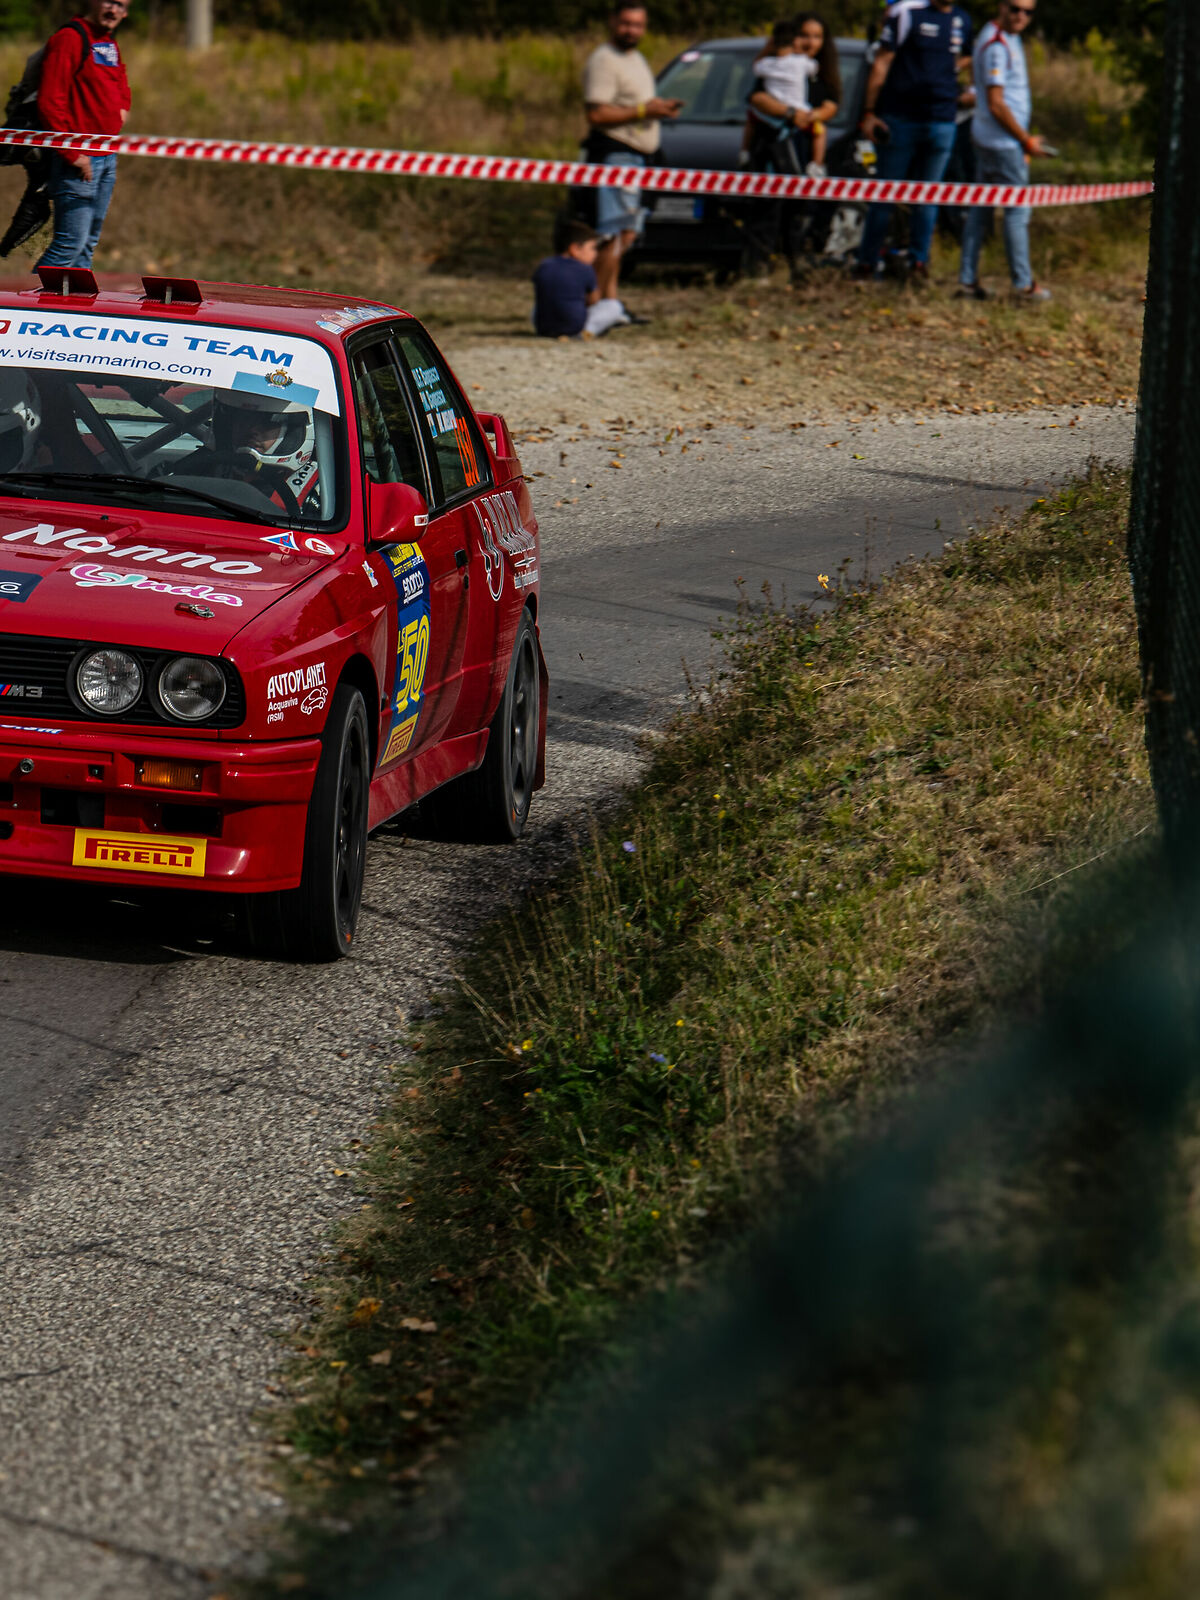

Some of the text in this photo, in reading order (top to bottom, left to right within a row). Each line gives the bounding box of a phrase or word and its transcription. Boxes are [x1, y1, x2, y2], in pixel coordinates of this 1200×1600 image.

[17, 321, 169, 347] RACING
[183, 336, 295, 368] TEAM
[1, 523, 263, 575] Nonno
[267, 661, 327, 700] AUTOPLANET
[395, 614, 431, 714] 50
[6, 684, 44, 698] M3
[84, 837, 195, 868] PIRELLI
